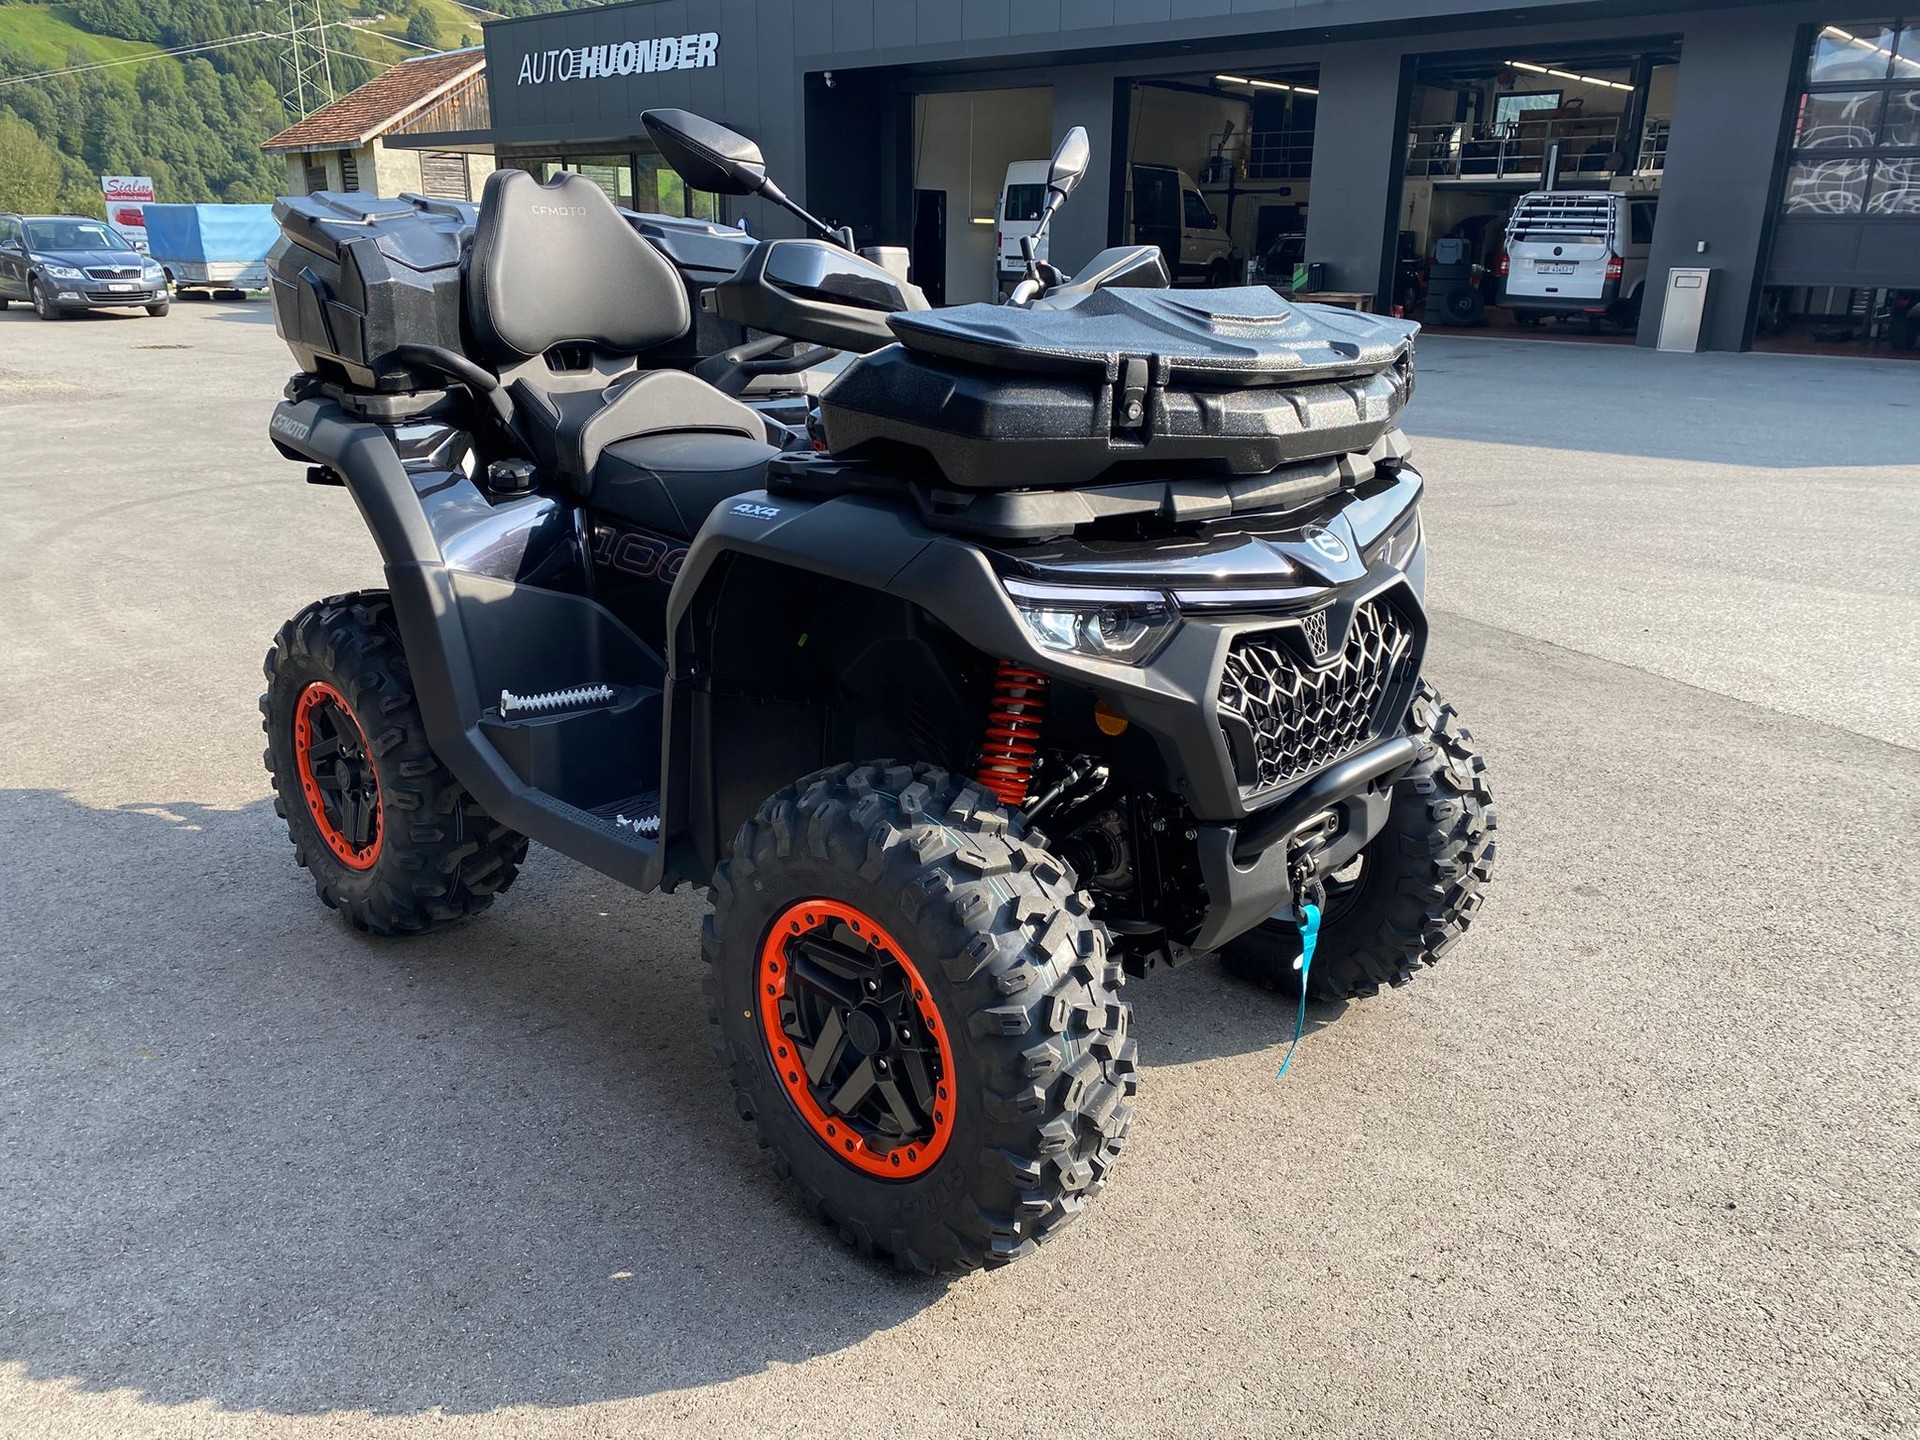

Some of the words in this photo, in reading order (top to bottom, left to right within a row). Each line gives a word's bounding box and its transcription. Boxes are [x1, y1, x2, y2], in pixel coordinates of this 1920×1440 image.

[517, 48, 574, 86] AUTO
[578, 32, 719, 79] HUONDER
[106, 179, 150, 193] Sialm
[531, 205, 587, 216] CFMOTO
[271, 413, 310, 440] CFMOTO
